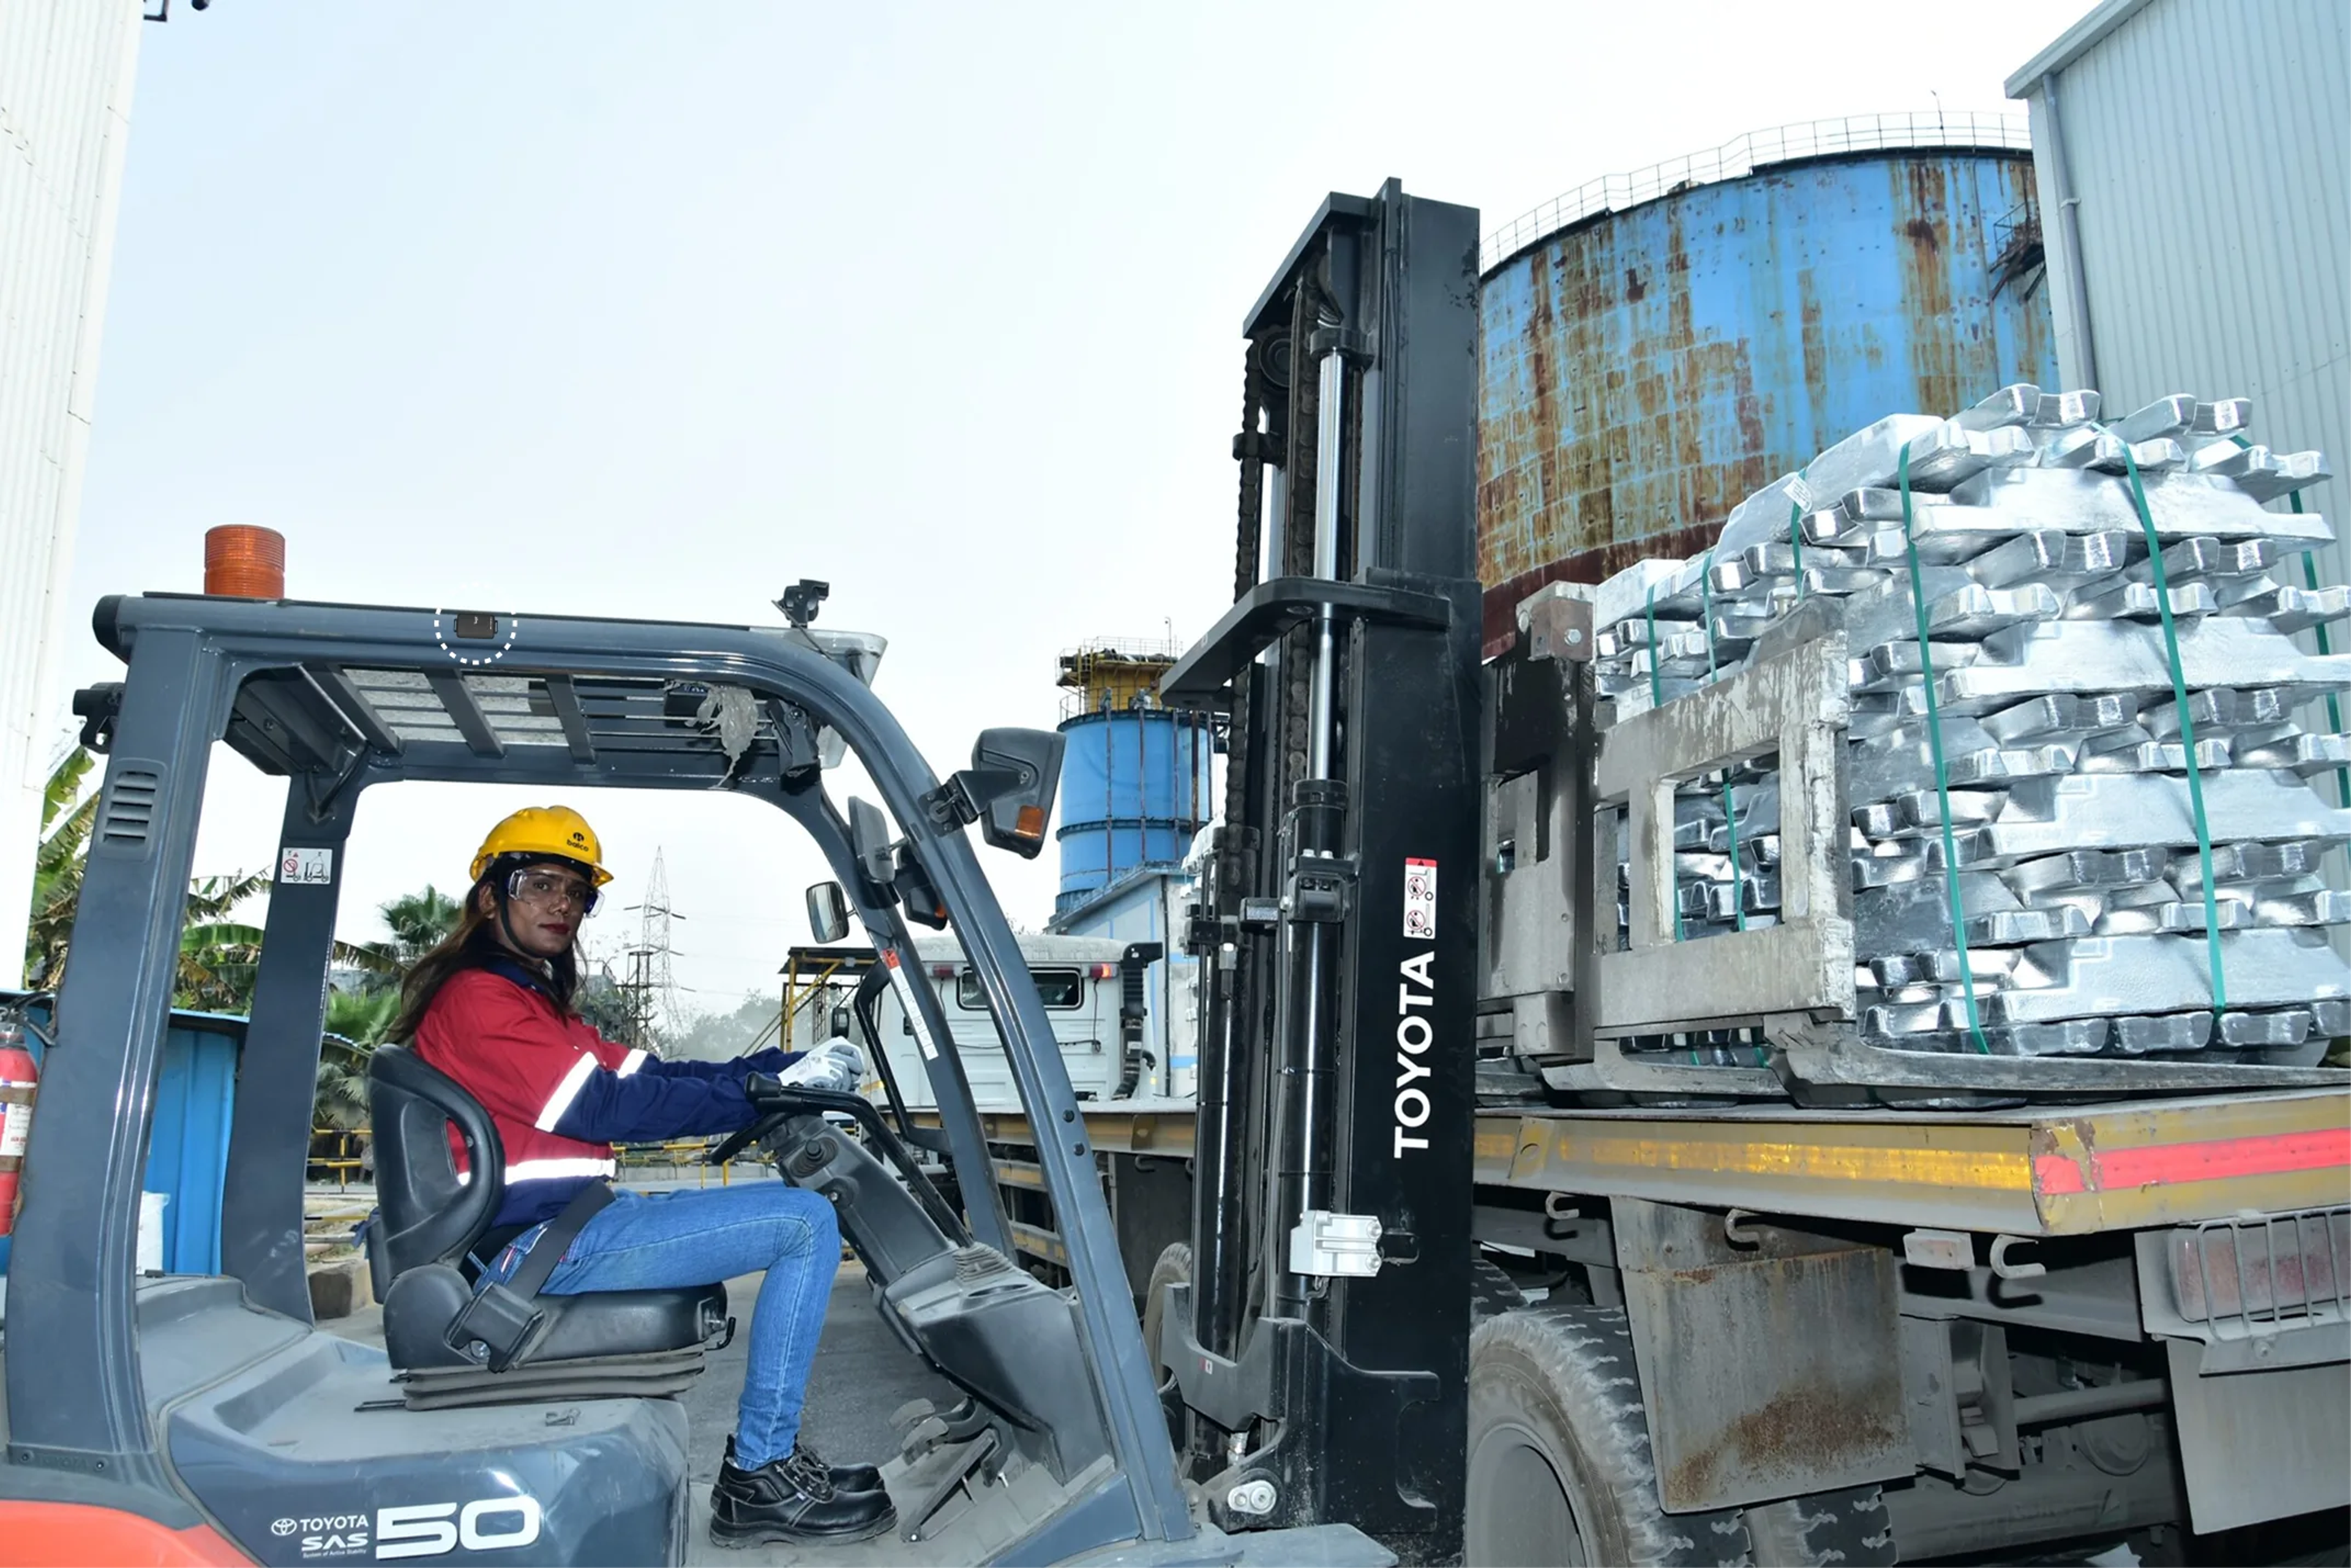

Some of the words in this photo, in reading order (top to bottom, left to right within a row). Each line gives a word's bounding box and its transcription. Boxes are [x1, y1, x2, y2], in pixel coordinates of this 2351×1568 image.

[566, 839, 589, 852] balco
[1393, 951, 1435, 1159] TOYOTA
[299, 1514, 369, 1532] TOYOTA
[376, 1495, 541, 1560] 50
[301, 1532, 369, 1551] SAS
